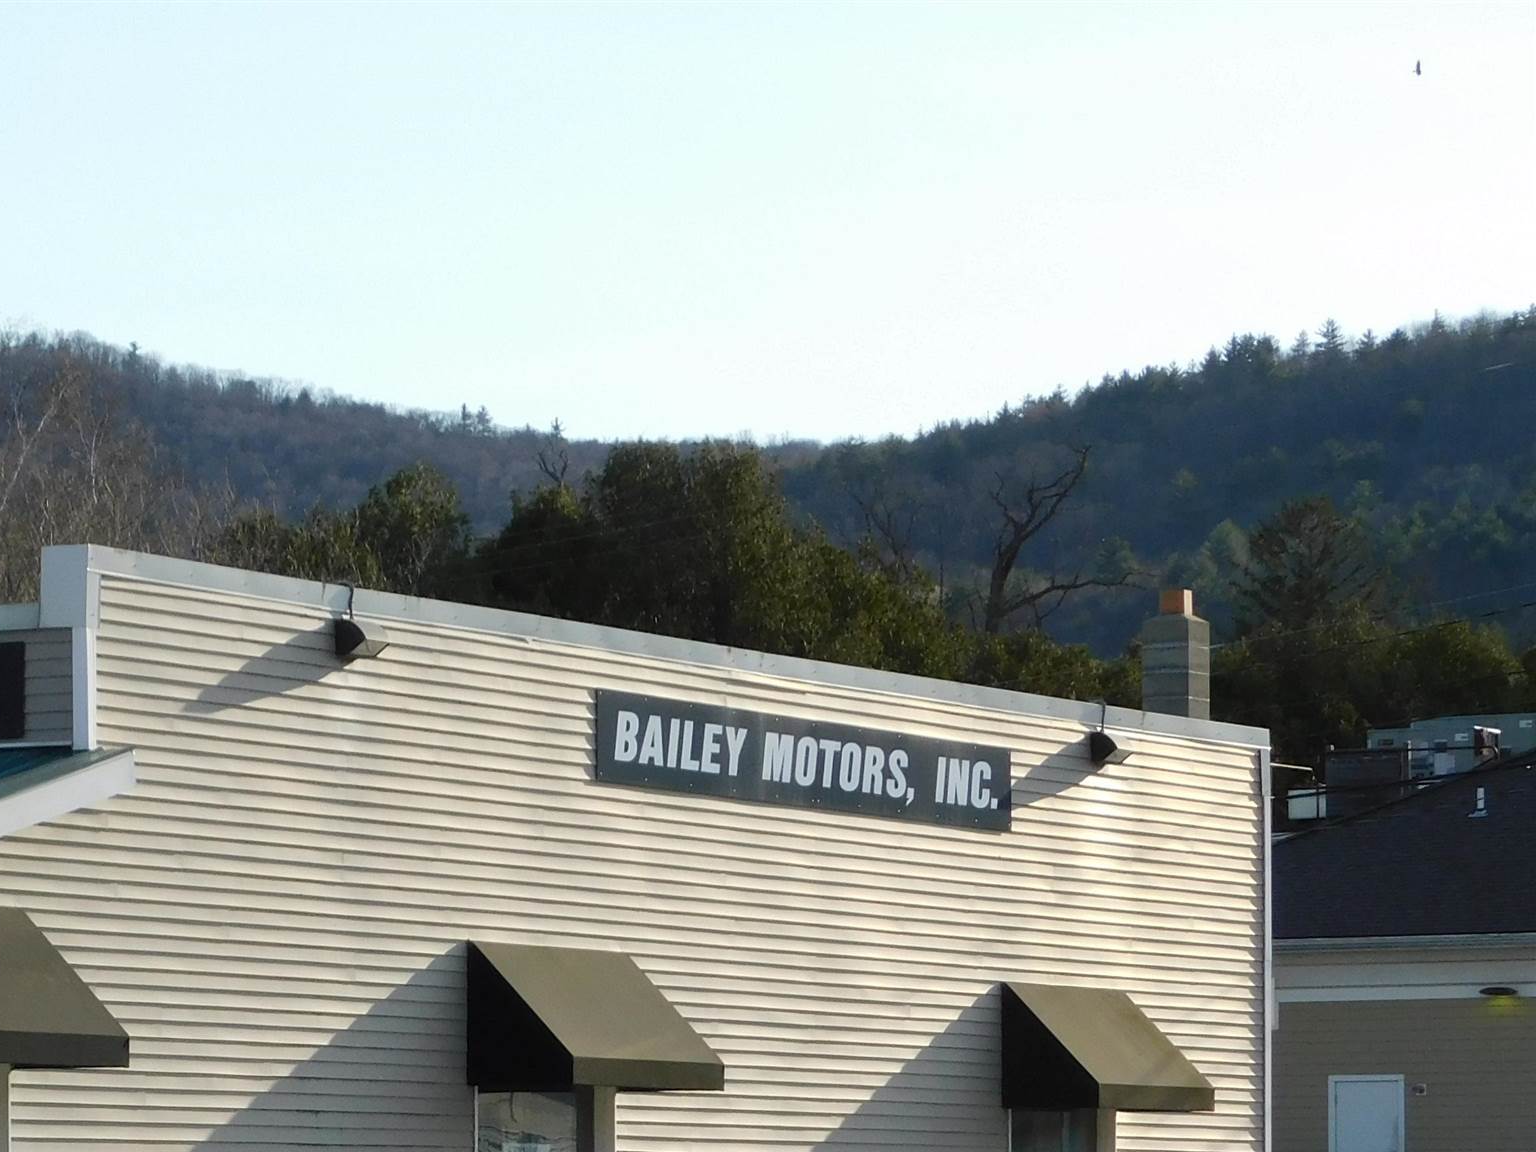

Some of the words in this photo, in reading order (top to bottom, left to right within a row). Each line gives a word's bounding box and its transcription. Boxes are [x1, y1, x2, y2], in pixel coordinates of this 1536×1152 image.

[614, 710, 748, 777] BAILEY
[761, 731, 915, 806] MOTORS,
[934, 756, 999, 810] INC.
